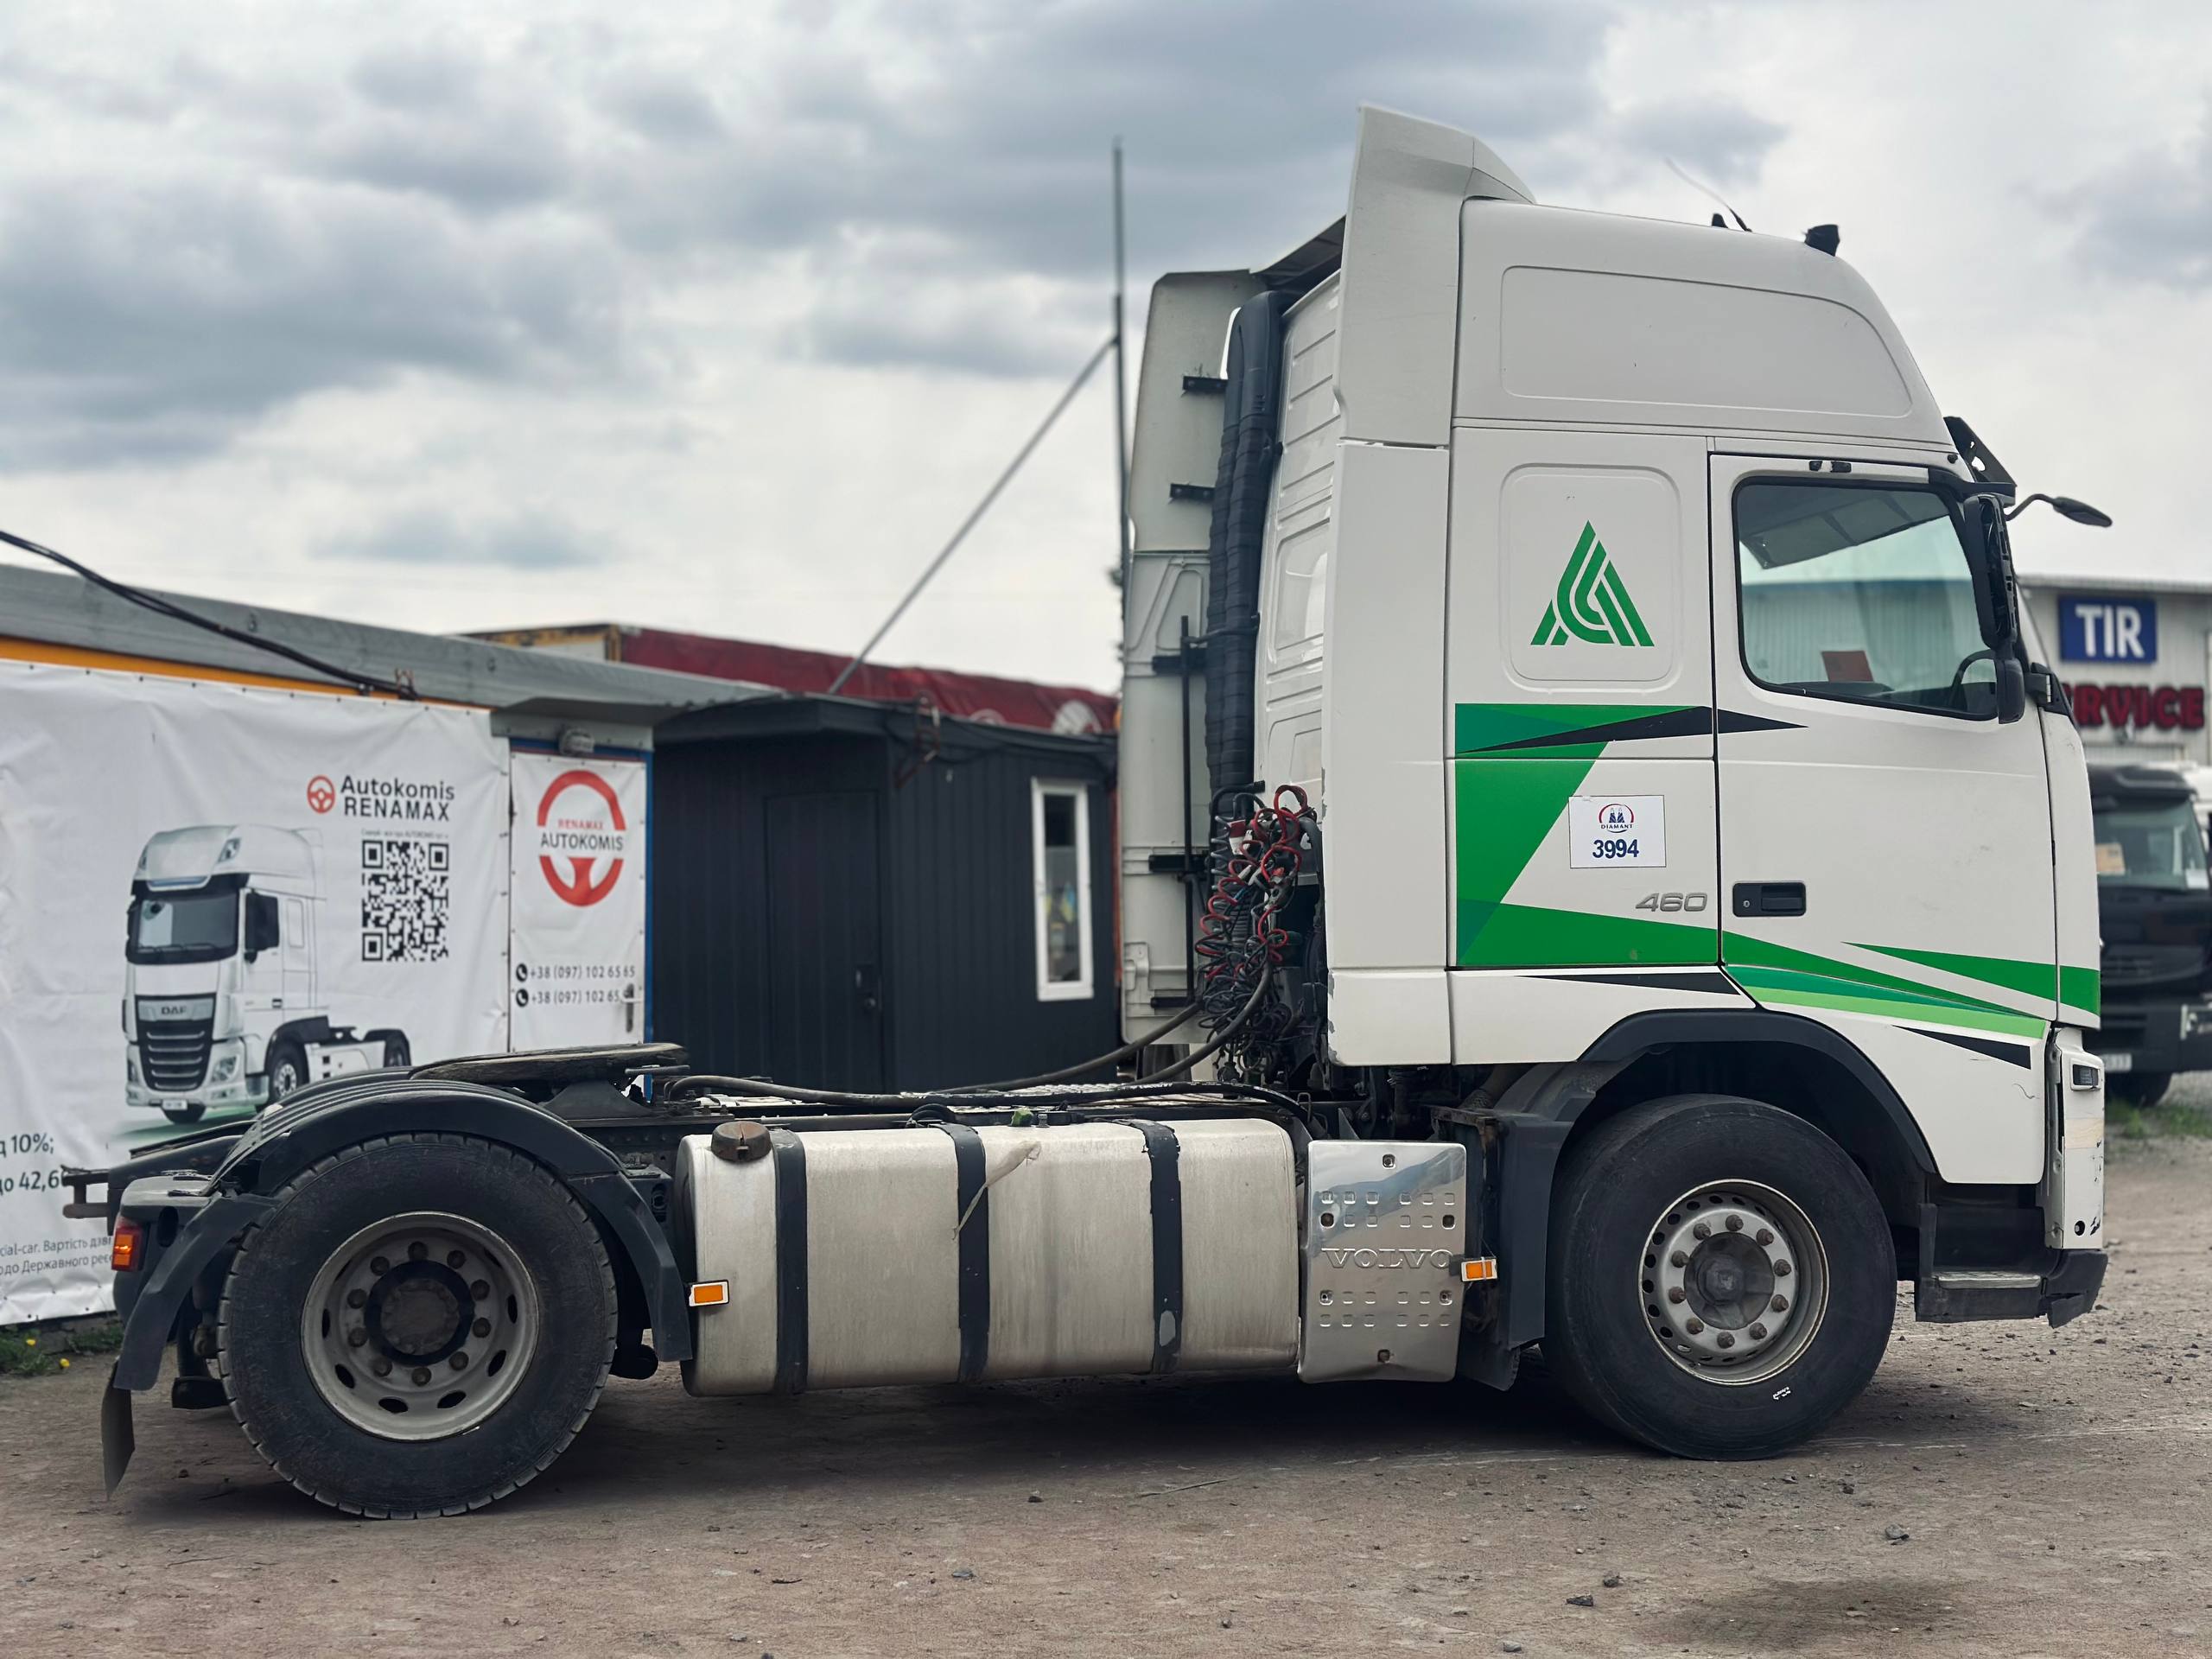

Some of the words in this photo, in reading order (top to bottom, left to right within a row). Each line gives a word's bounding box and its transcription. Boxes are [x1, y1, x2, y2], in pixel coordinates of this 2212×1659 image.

[2075, 606, 2145, 658] TIR
[2062, 682, 2205, 731] RVICE
[340, 776, 455, 801] Autokomis
[344, 797, 449, 822] RENAMAX
[557, 818, 604, 830] RENAMAX
[540, 832, 624, 851] AUTOKOMIS
[1592, 839, 1640, 859] 3994
[1635, 893, 1707, 912] 460
[530, 965, 550, 979] +38
[553, 964, 582, 980] (097)
[586, 965, 605, 978] 102
[531, 990, 550, 1004] +38
[553, 989, 582, 1004] (097)
[586, 989, 605, 1002] 102
[11, 1133, 54, 1154] 10%;
[22, 1256, 89, 1274] Державного
[1321, 1248, 1453, 1269] VOLVO
